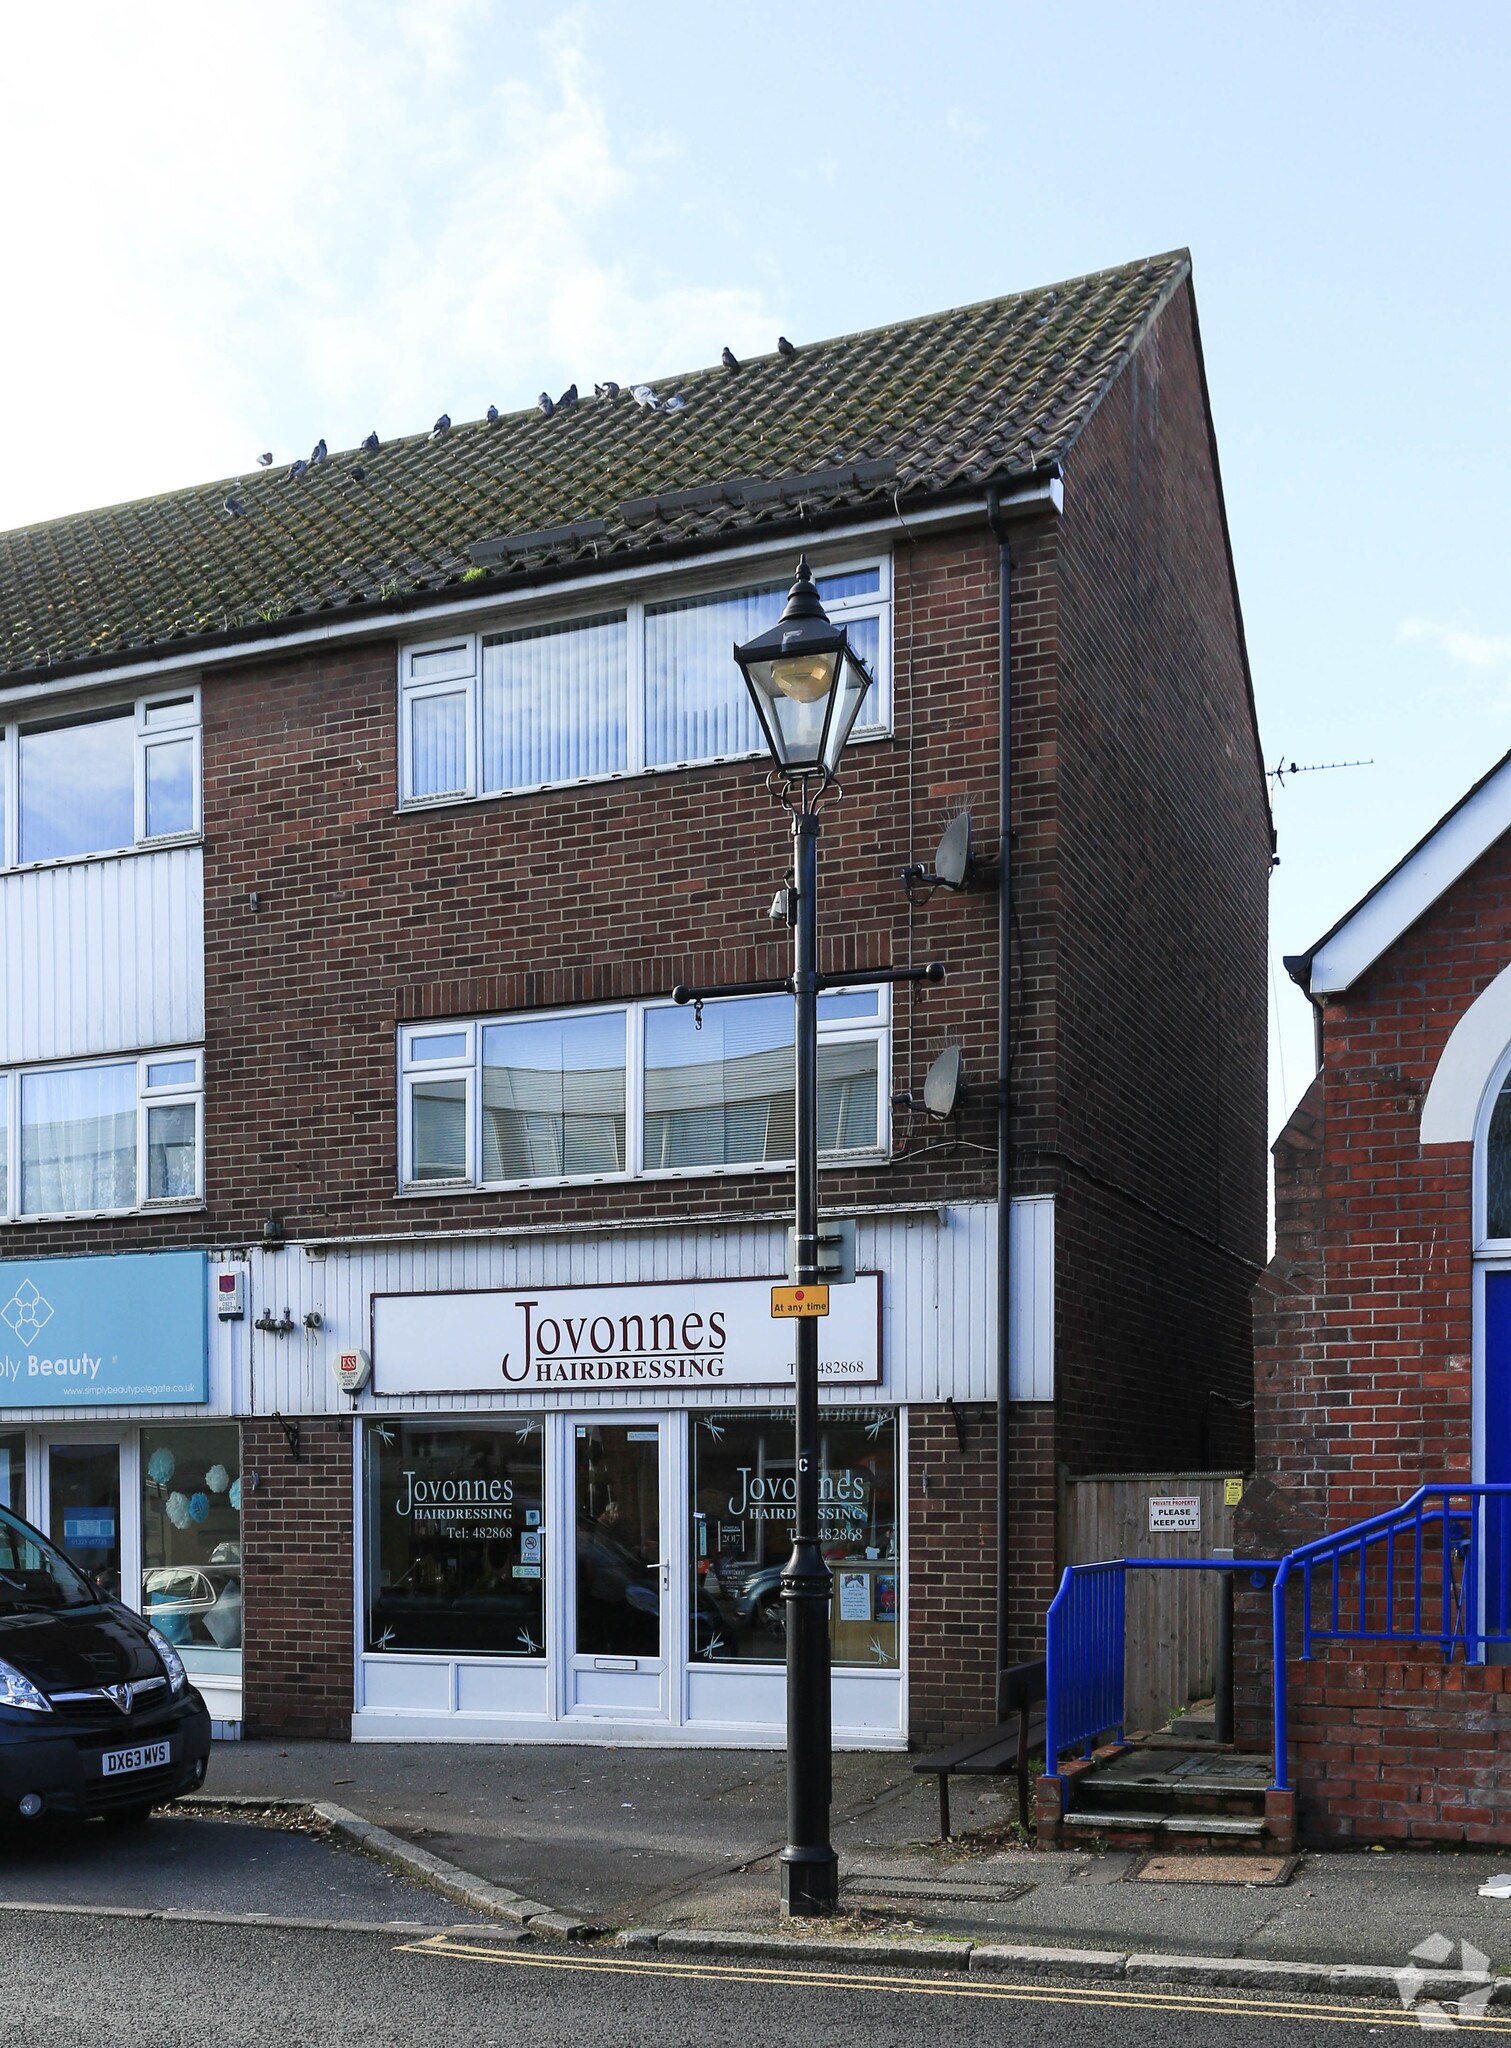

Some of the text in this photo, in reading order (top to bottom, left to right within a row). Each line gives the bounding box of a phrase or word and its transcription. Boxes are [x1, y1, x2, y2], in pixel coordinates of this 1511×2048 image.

[774, 1302, 826, 1313] At any time
[501, 1301, 727, 1382] Jovonnes
[28, 1353, 102, 1380] Beauty
[535, 1357, 725, 1382] HAIRDRESSING
[817, 1360, 864, 1374] 482868
[63, 1383, 195, 1396] www.simplybeautypolegate.co.uk
[396, 1471, 514, 1516] Jovonnes
[728, 1467, 864, 1515] Jovones
[414, 1508, 512, 1520] HAIRDRESSING
[749, 1507, 863, 1520] HAIRDSSING
[1158, 1508, 1191, 1516] PLEASE
[446, 1527, 513, 1539] Tel: 482868
[722, 1534, 741, 1545] 2017
[817, 1528, 863, 1541] 482868
[108, 1745, 166, 1771] DX63 MVS
